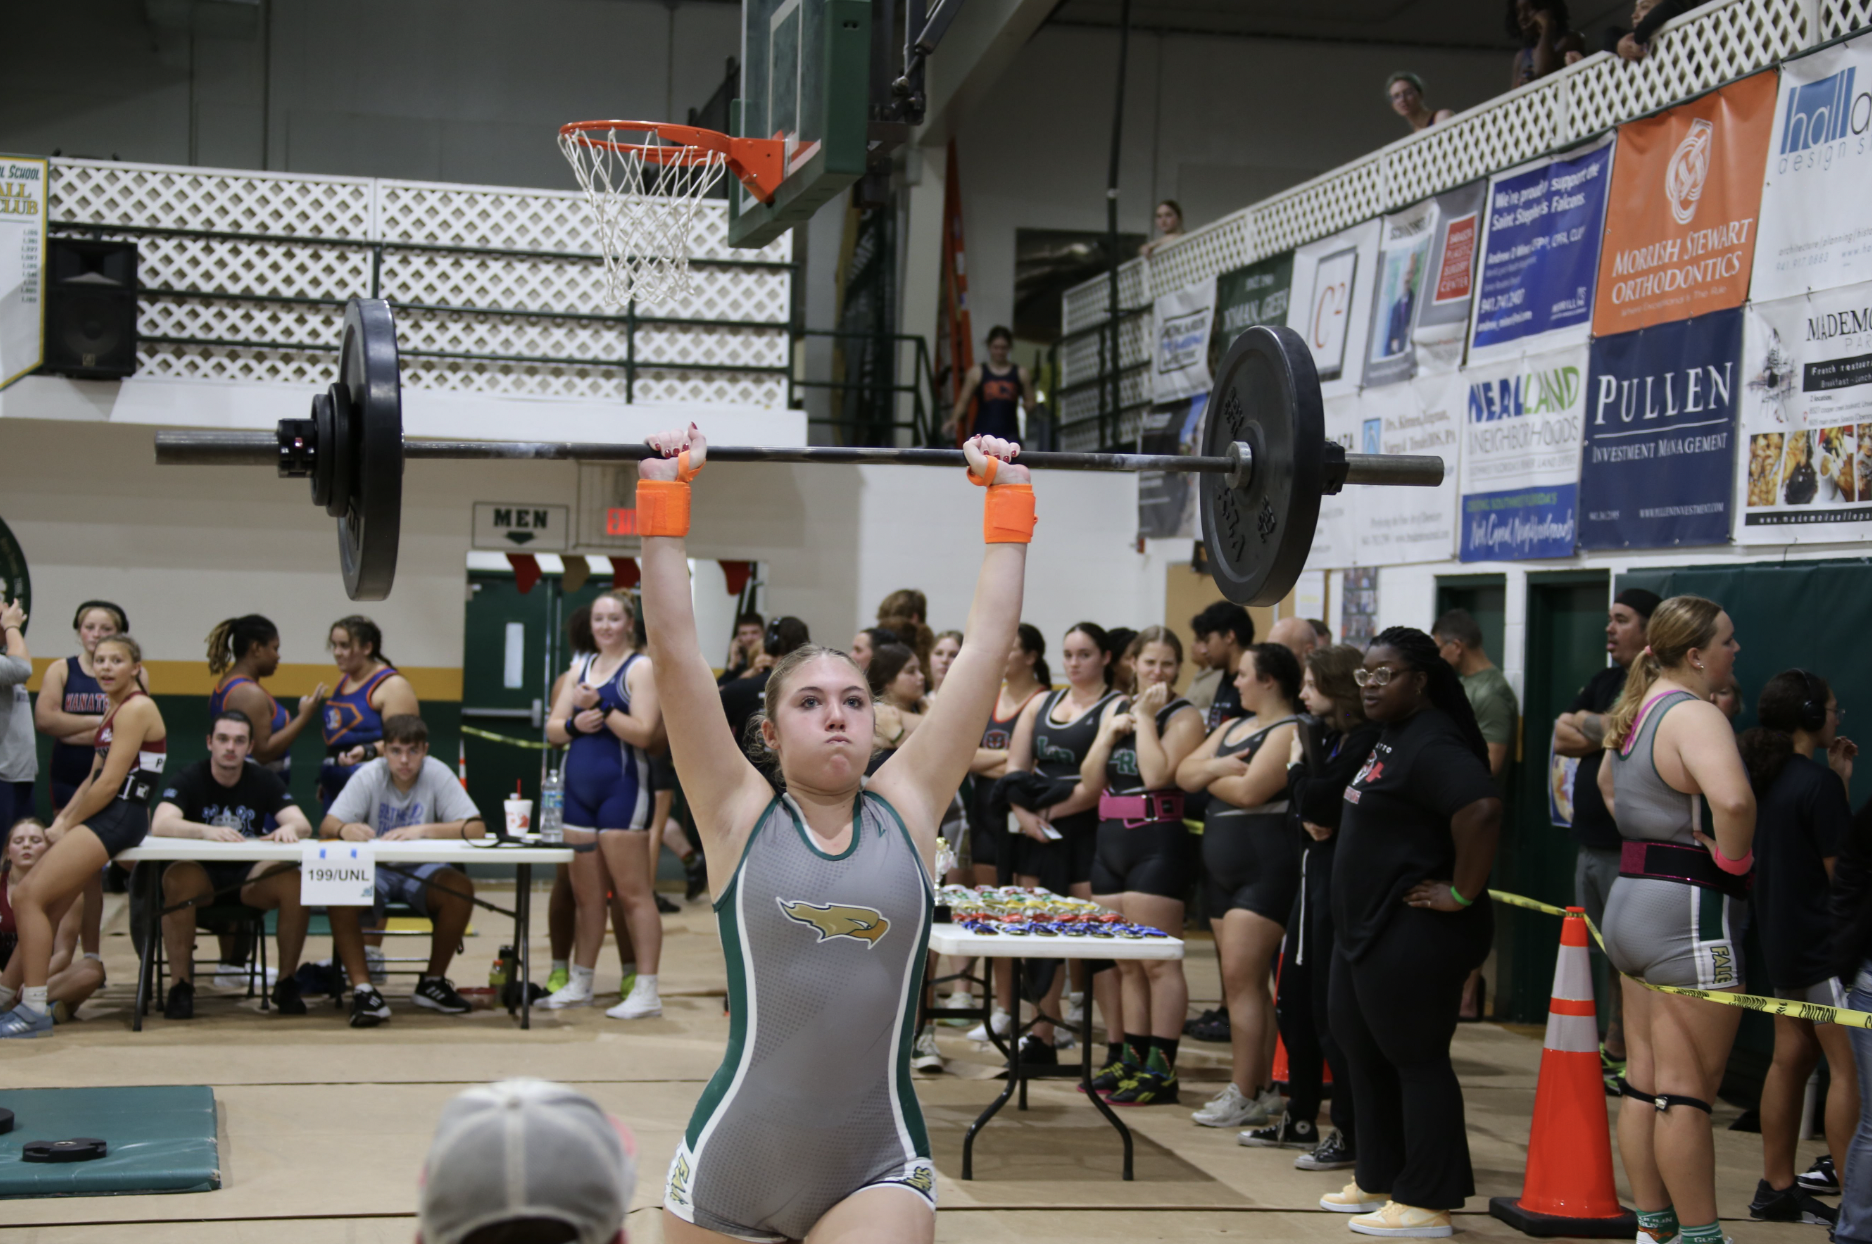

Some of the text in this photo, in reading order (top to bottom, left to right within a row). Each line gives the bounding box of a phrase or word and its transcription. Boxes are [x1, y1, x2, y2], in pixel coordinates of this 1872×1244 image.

[1778, 141, 1846, 175] design
[1491, 213, 1515, 232] Saint
[1611, 218, 1753, 278] MORRISH STEWART
[1611, 251, 1742, 305] ORTHODONTICS
[1806, 307, 1872, 342] MADEM
[1594, 362, 1733, 425] PULLEN
[1592, 432, 1728, 463] INVESTMENT MANAGEMENT
[494, 508, 548, 529] MEN
[307, 868, 369, 881] 199/UNL
[1800, 1003, 1838, 1024] CAUTION
